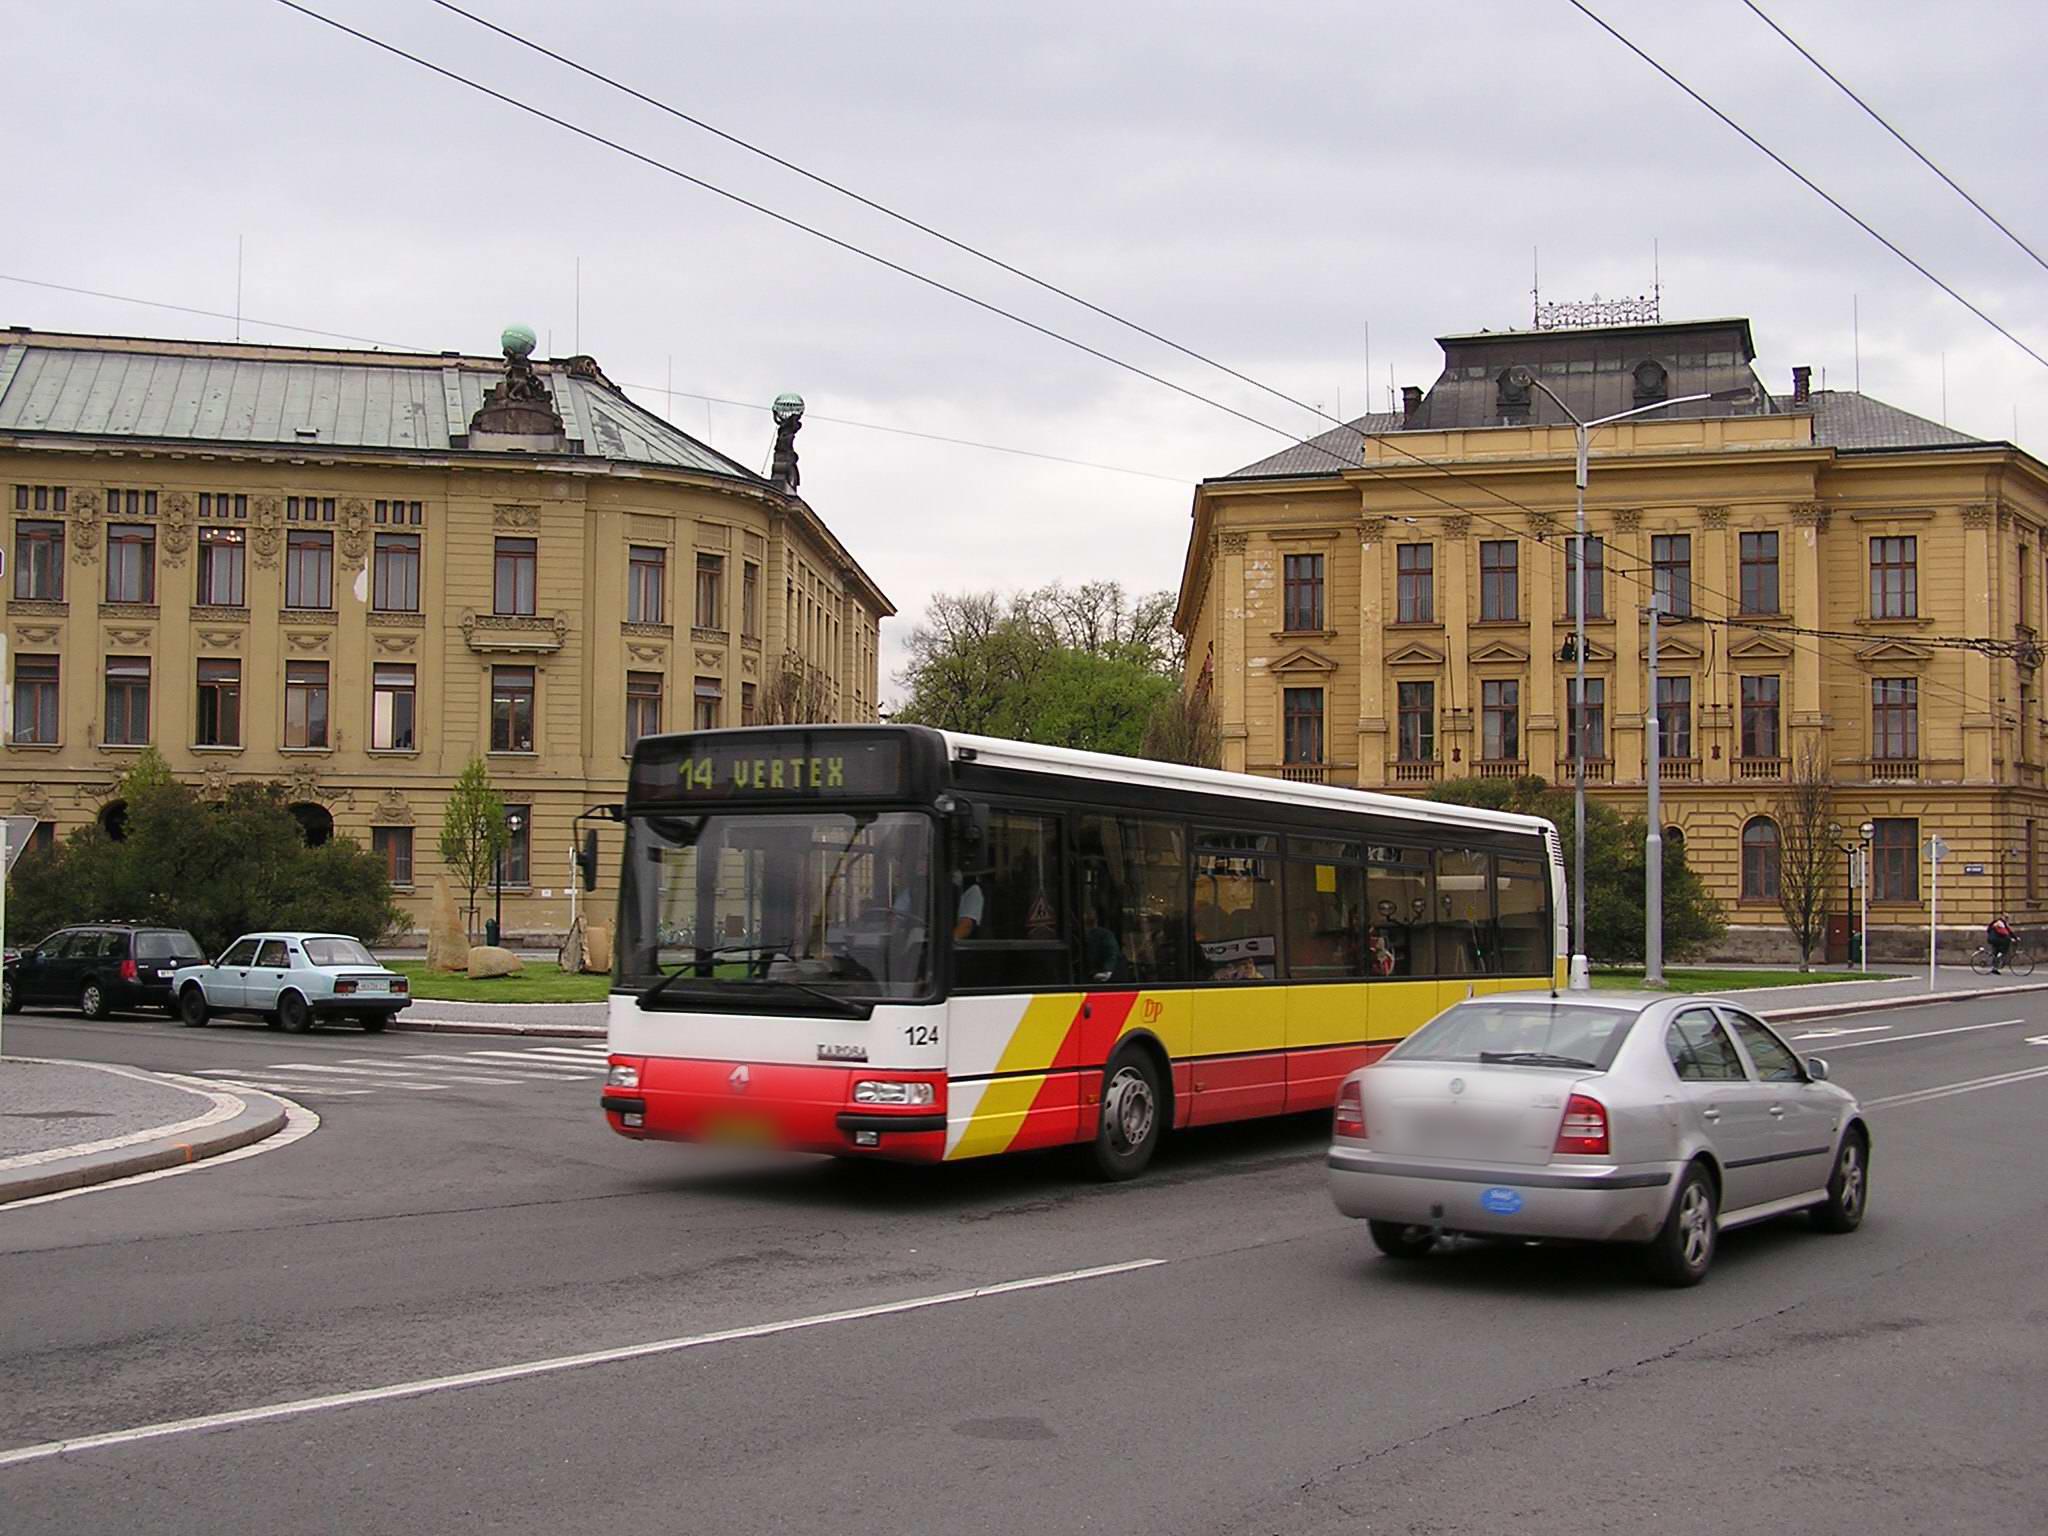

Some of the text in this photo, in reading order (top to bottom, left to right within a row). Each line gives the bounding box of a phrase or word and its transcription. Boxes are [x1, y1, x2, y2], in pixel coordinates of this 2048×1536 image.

[678, 757, 844, 790] 14 VERTEX
[904, 1025, 939, 1046] 124
